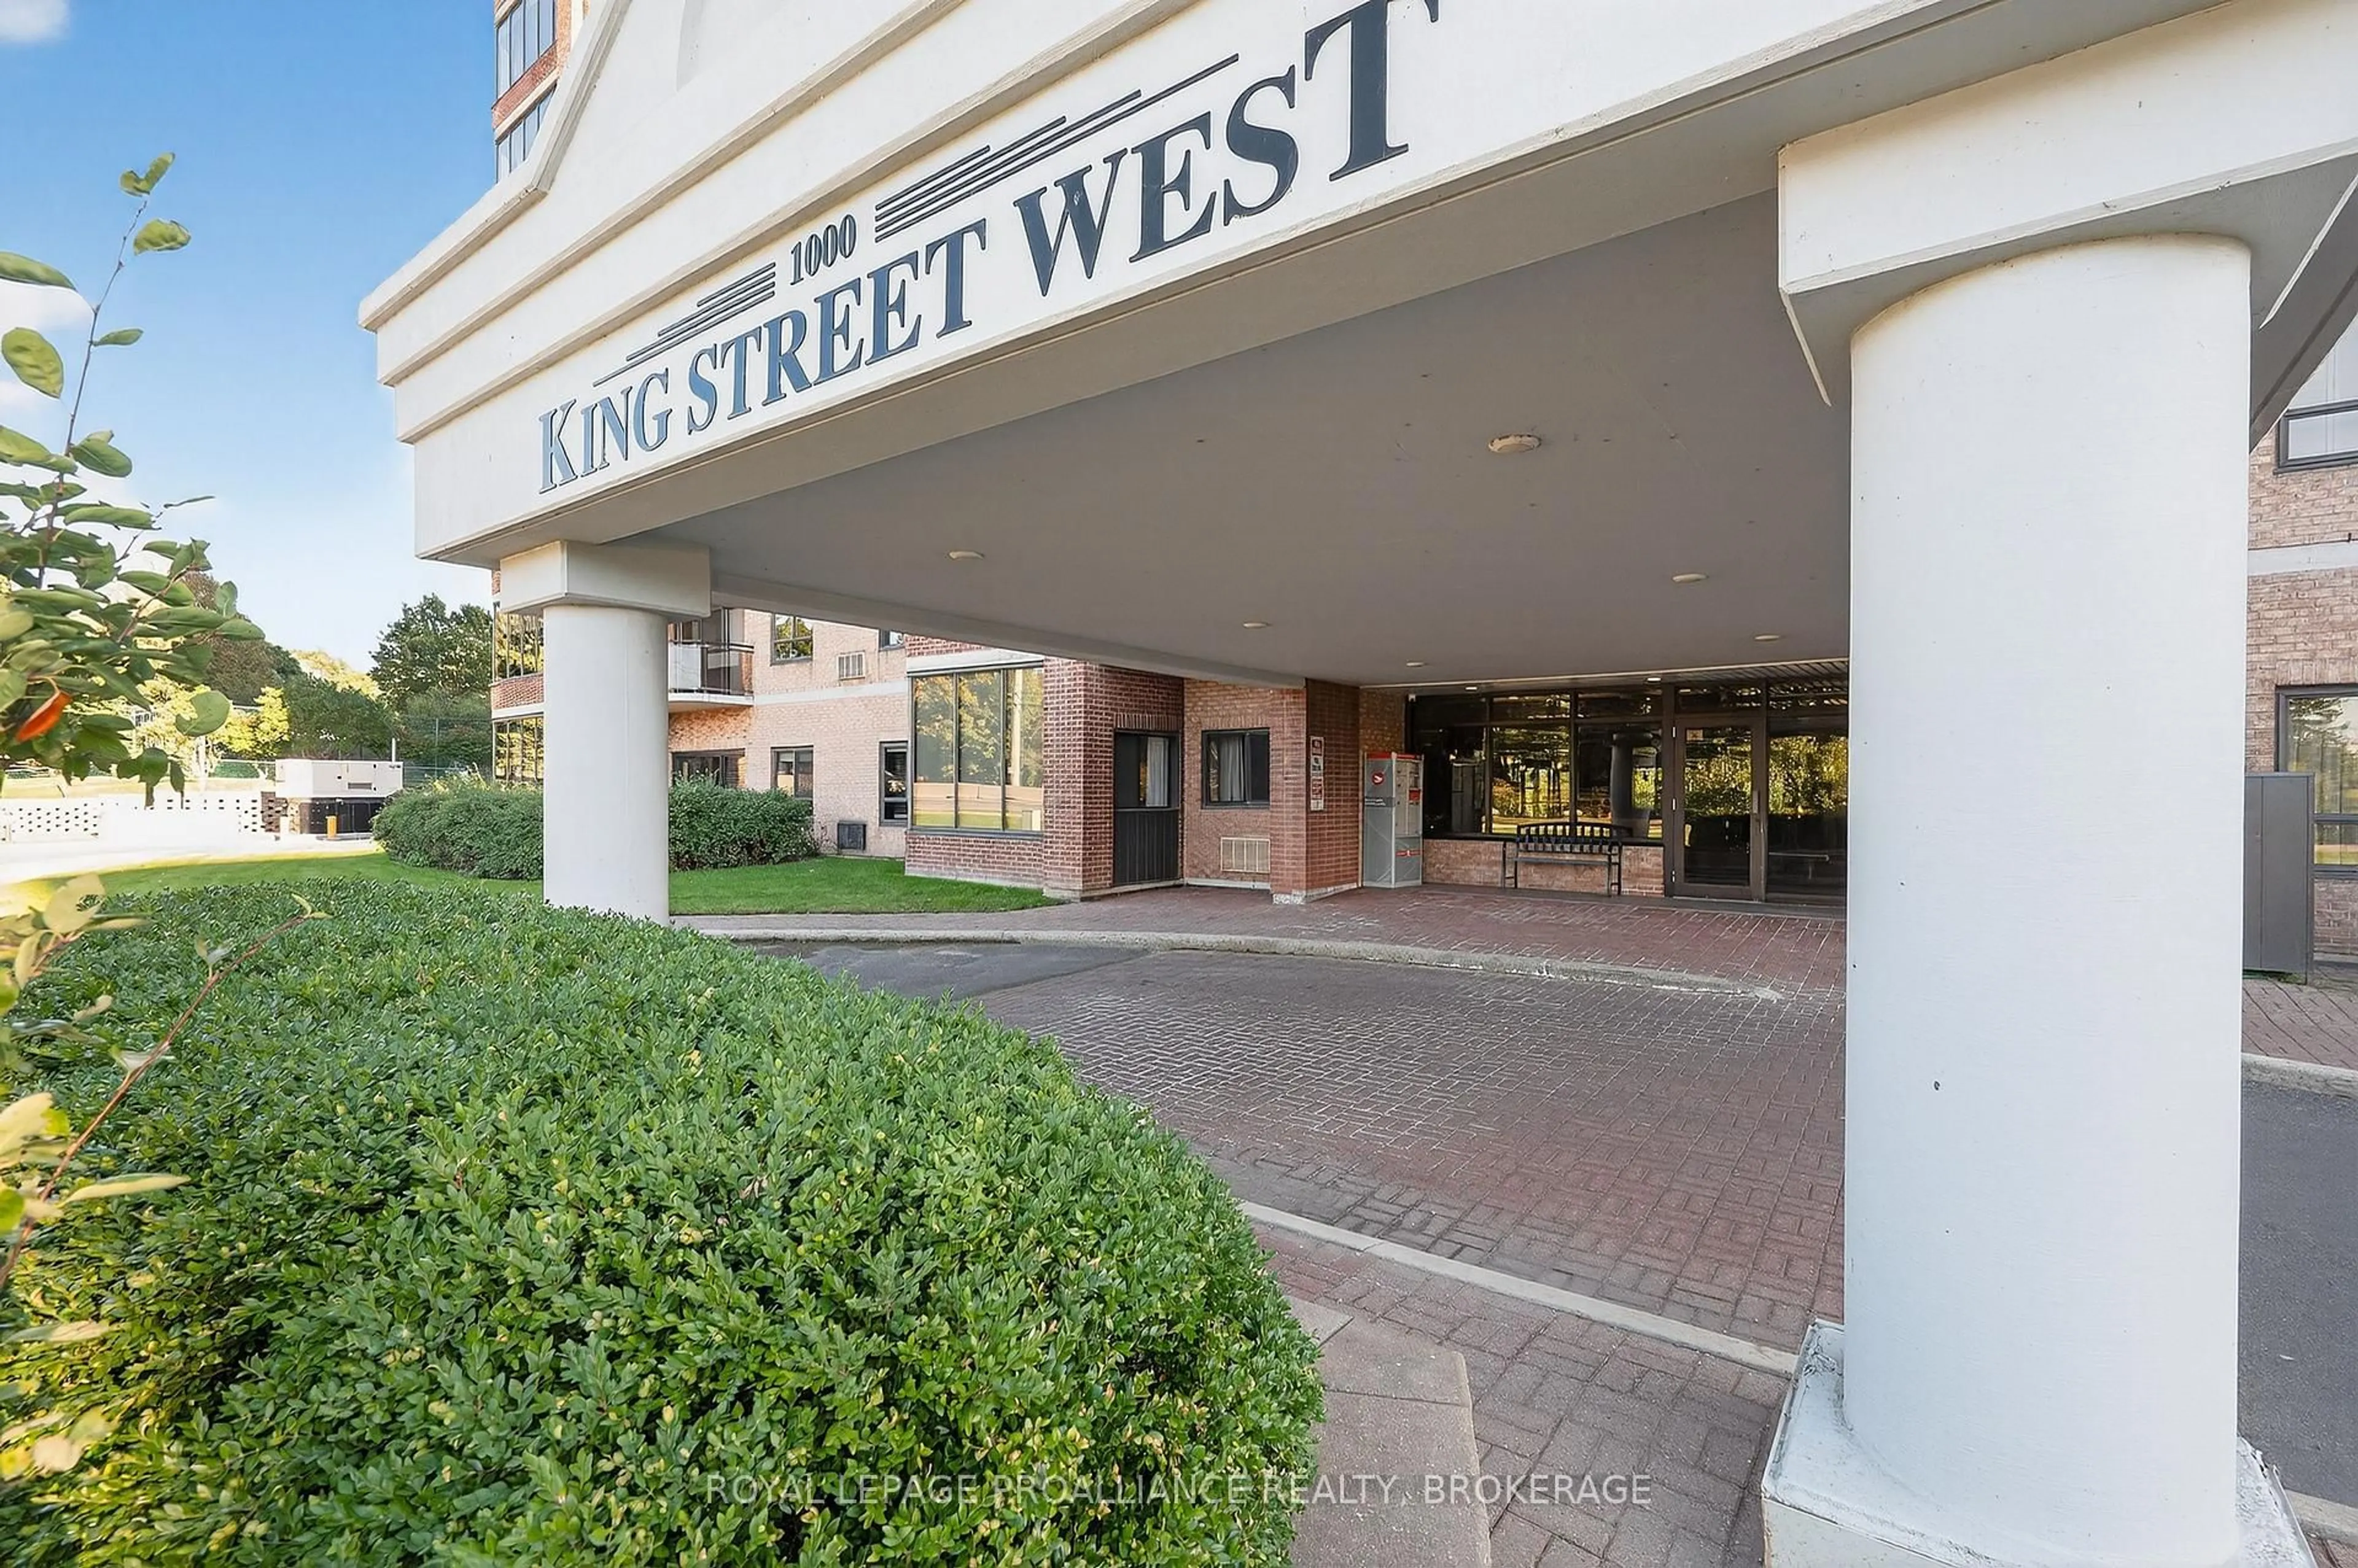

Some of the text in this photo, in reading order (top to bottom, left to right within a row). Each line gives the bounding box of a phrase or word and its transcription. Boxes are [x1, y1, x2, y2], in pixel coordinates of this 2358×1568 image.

[539, 0, 1439, 494] KING STREET WEST
[790, 213, 858, 286] 1000
